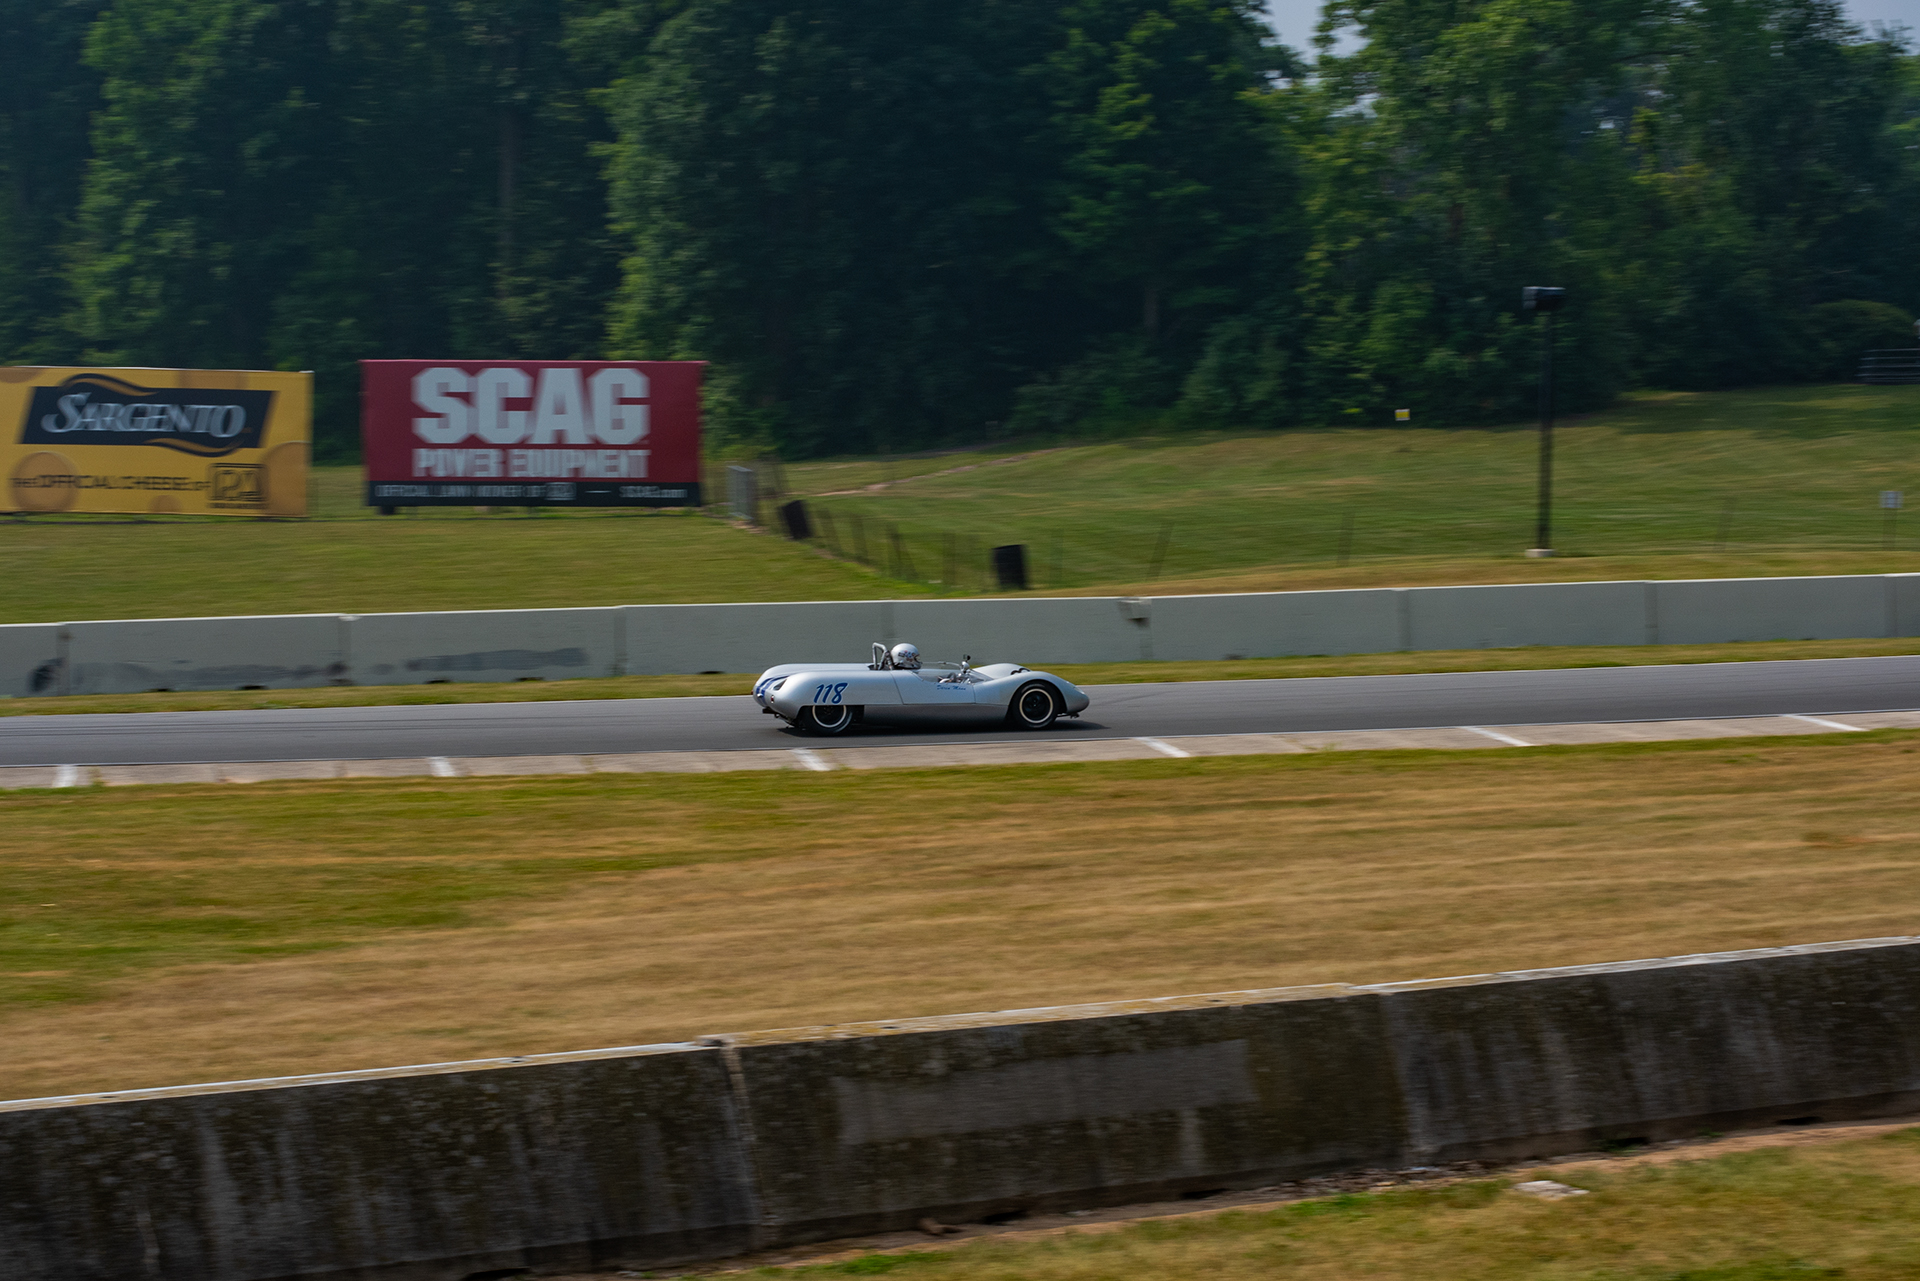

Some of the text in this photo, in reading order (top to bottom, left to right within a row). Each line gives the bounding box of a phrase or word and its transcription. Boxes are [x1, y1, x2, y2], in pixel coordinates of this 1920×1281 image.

[411, 367, 650, 445] SCAG
[411, 448, 651, 478] POWER EQUIPMENT
[813, 682, 849, 705] 118
